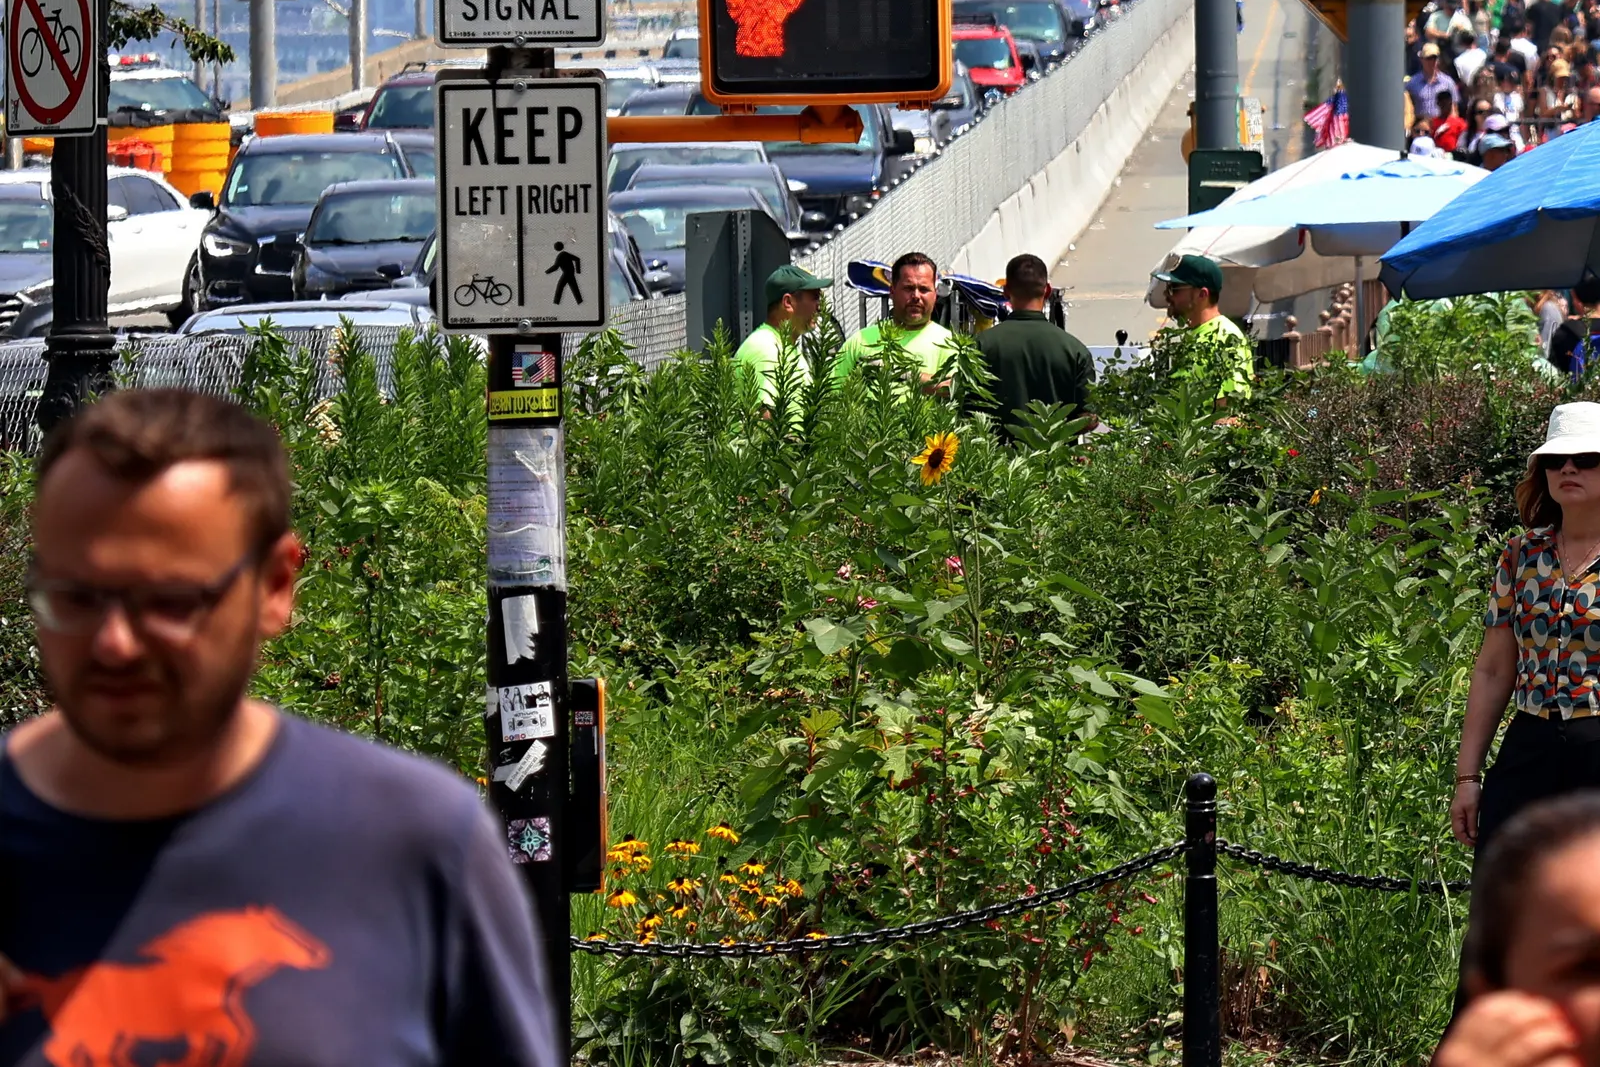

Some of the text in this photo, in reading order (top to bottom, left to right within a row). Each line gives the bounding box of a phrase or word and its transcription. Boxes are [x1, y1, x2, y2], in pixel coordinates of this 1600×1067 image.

[462, 106, 583, 165] KEEP
[455, 184, 591, 216] LEFT RIGHT
